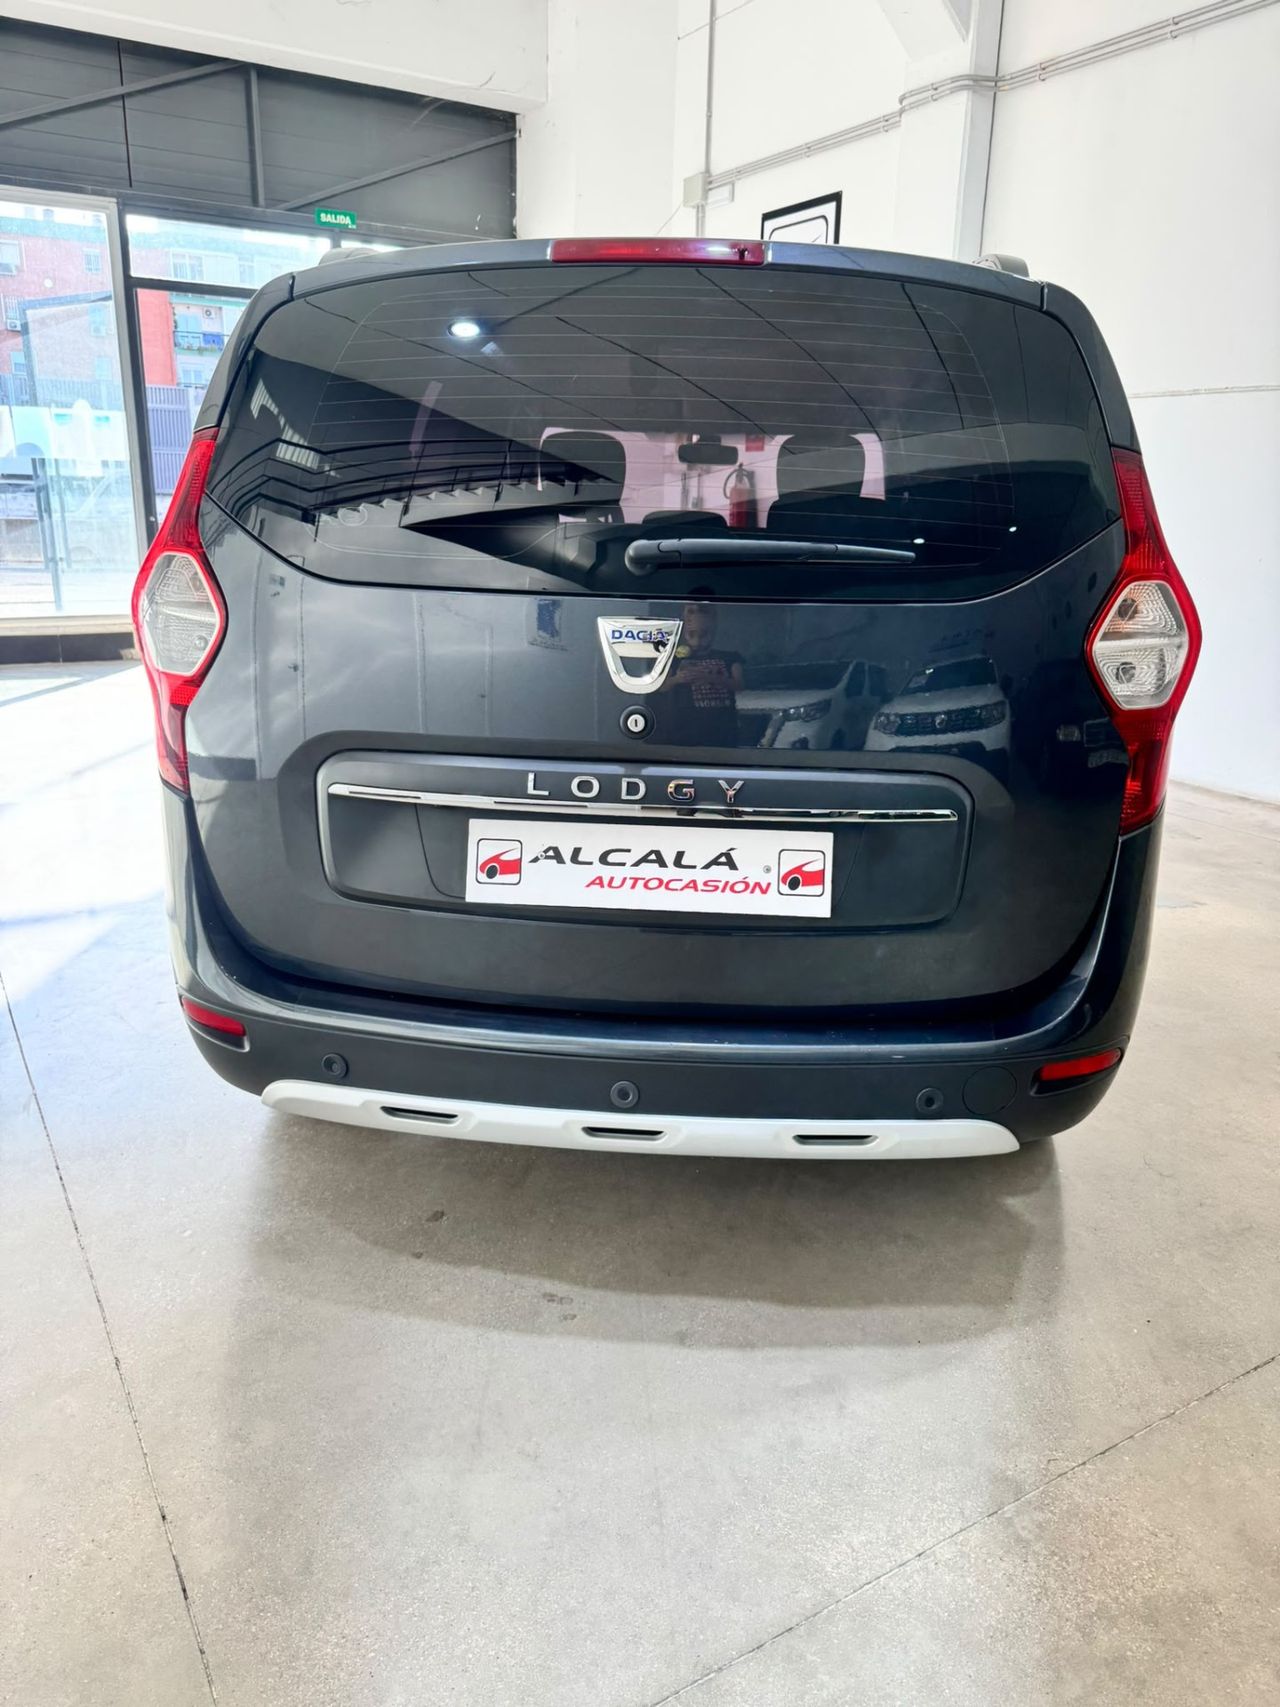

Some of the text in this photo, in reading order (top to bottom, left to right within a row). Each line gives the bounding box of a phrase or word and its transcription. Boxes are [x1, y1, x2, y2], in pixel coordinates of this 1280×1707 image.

[320, 213, 351, 224] SALIDA
[527, 772, 745, 803] LODGY
[528, 845, 739, 871] ALCALÁ
[585, 875, 772, 895] AUTOCASIÓN
